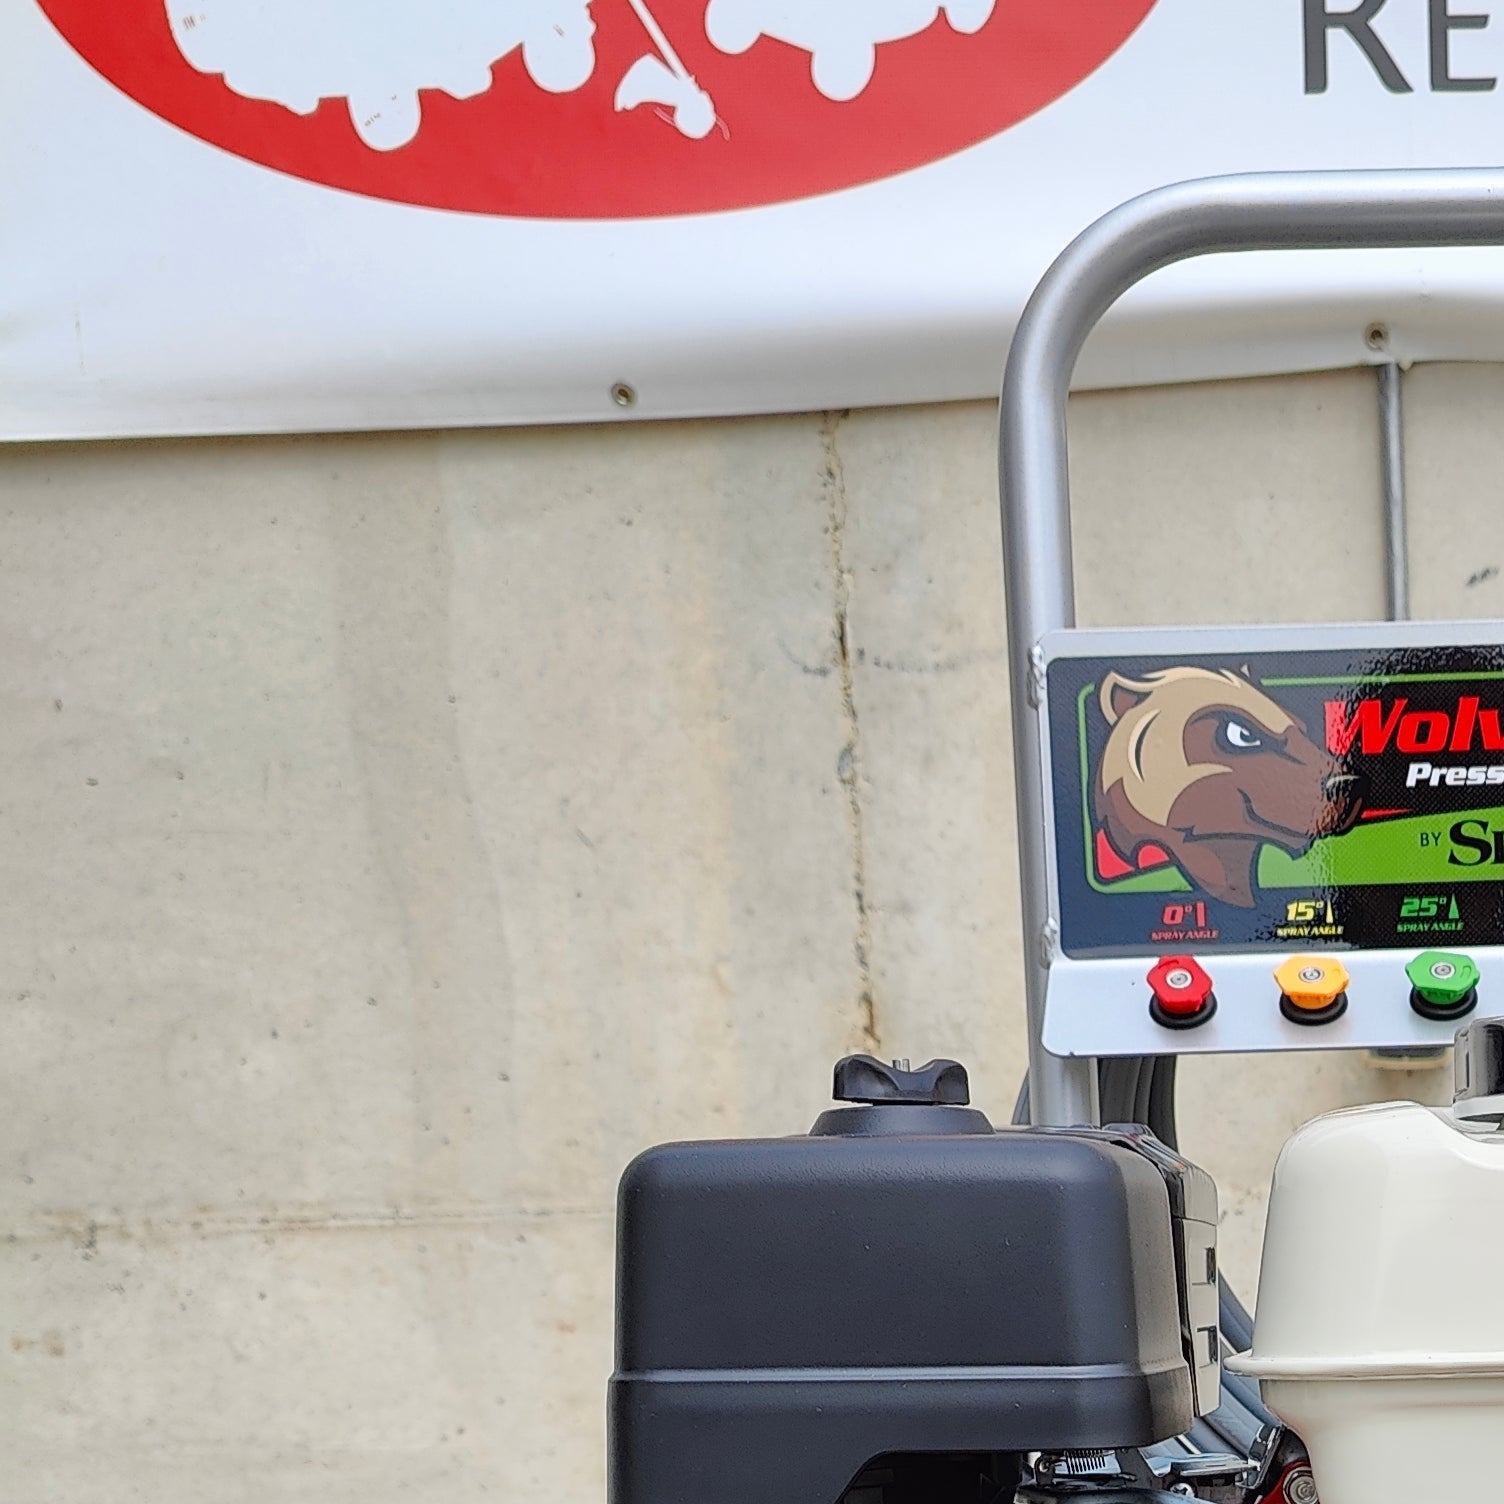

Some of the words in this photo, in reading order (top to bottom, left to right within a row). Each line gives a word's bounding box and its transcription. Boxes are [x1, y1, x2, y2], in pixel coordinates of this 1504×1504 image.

[1419, 832, 1441, 848] BY
[1277, 926, 1309, 937] SPRAY
[1310, 925, 1344, 936] ANGLE
[1397, 922, 1429, 933] SPRAY
[1431, 921, 1464, 931] ANGLE
[1152, 930, 1185, 941] SPRAY
[1186, 929, 1219, 939] ANGLE
